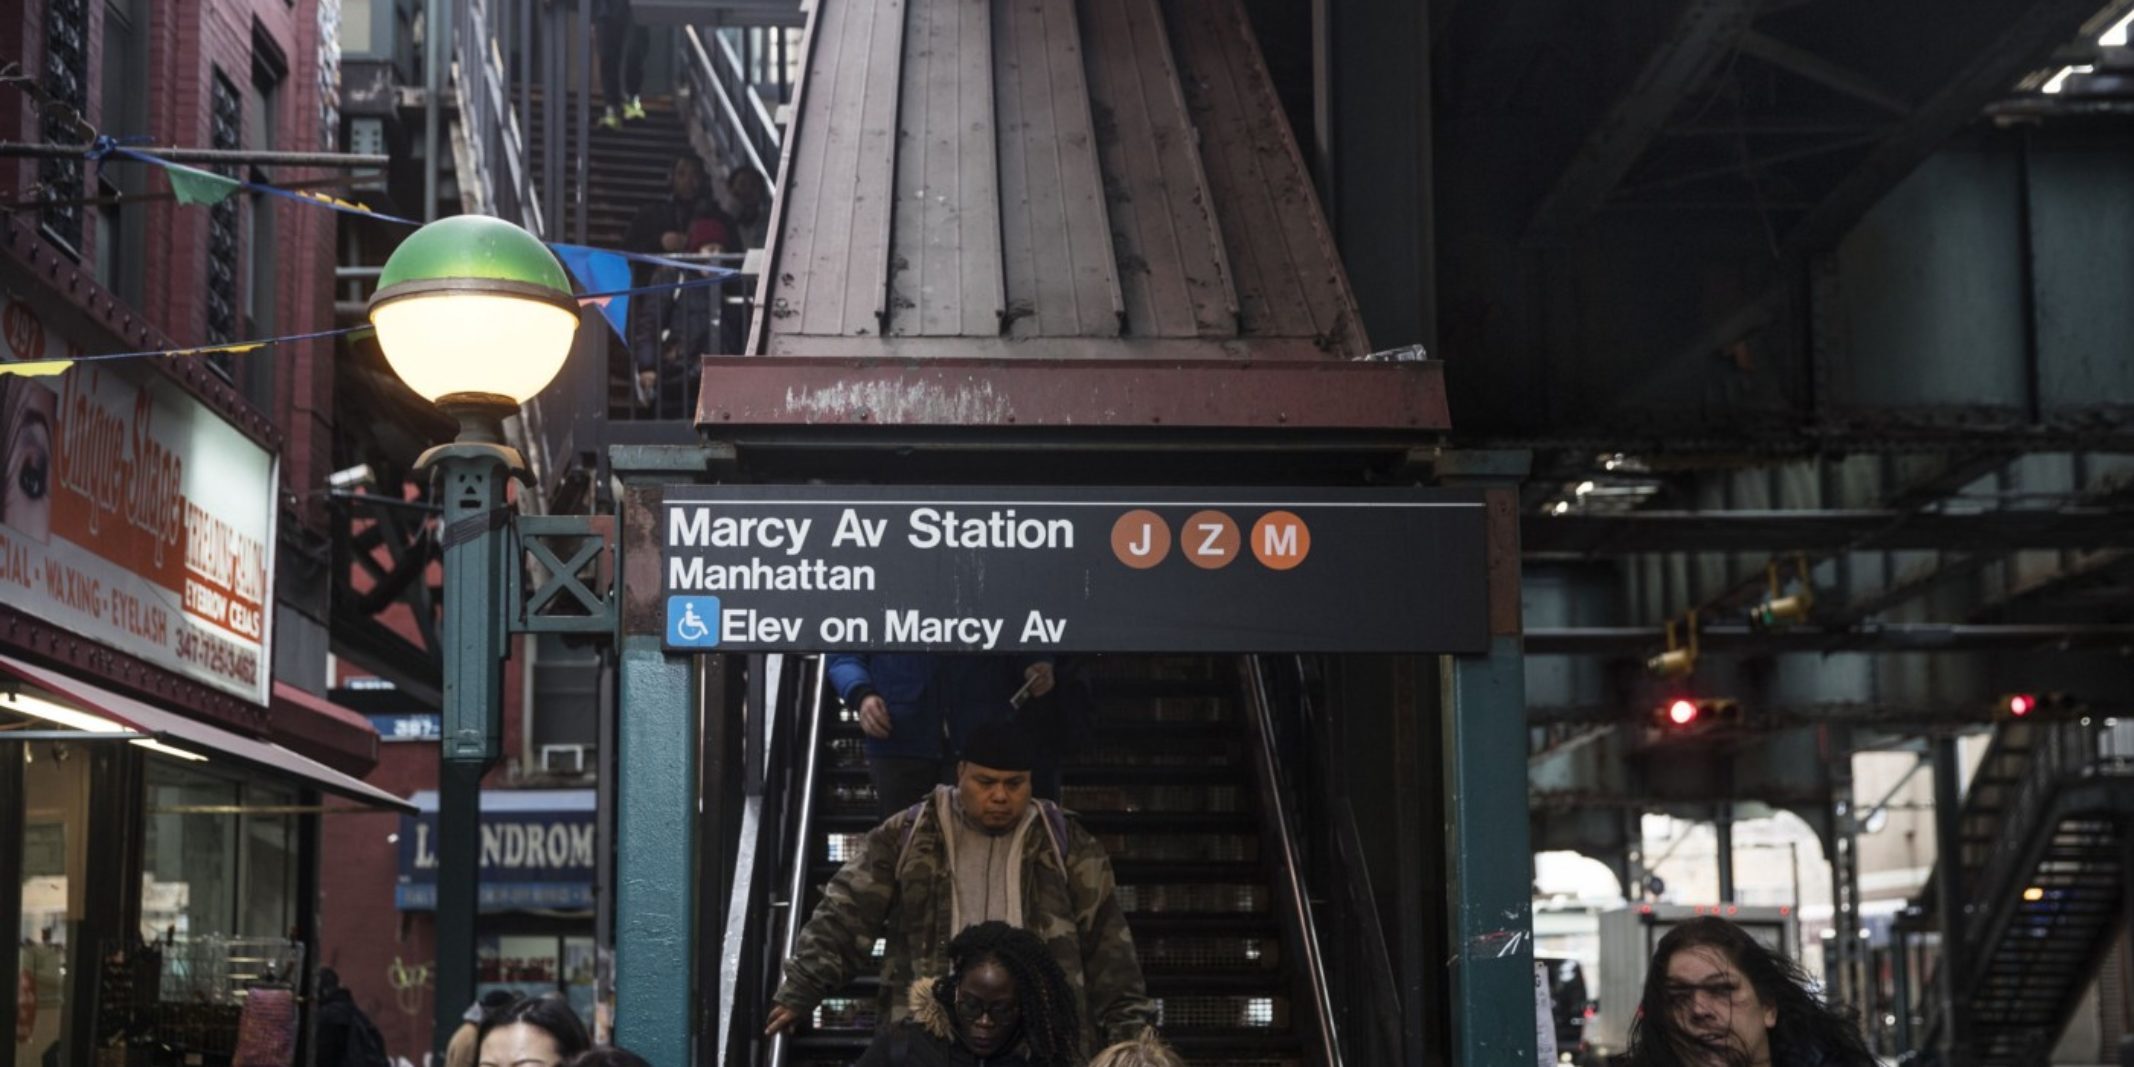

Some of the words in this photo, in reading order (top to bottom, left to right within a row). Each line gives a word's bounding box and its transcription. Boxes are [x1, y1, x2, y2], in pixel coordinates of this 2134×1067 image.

[55, 342, 124, 535] Unique
[124, 386, 185, 568] Shape
[668, 507, 813, 558] Marcy
[831, 508, 888, 548] Av
[907, 507, 1075, 549] Station
[1129, 523, 1152, 556] J
[1197, 523, 1225, 556] Z
[1264, 523, 1298, 556] M
[669, 556, 876, 591] Manhattan
[45, 556, 101, 618] WAXING
[112, 588, 167, 645] EYELASH
[721, 608, 804, 643] Elev
[819, 616, 869, 643] on
[884, 609, 1004, 650] Marcy
[1019, 609, 1068, 643] Av
[414, 823, 595, 868] LNDROM
